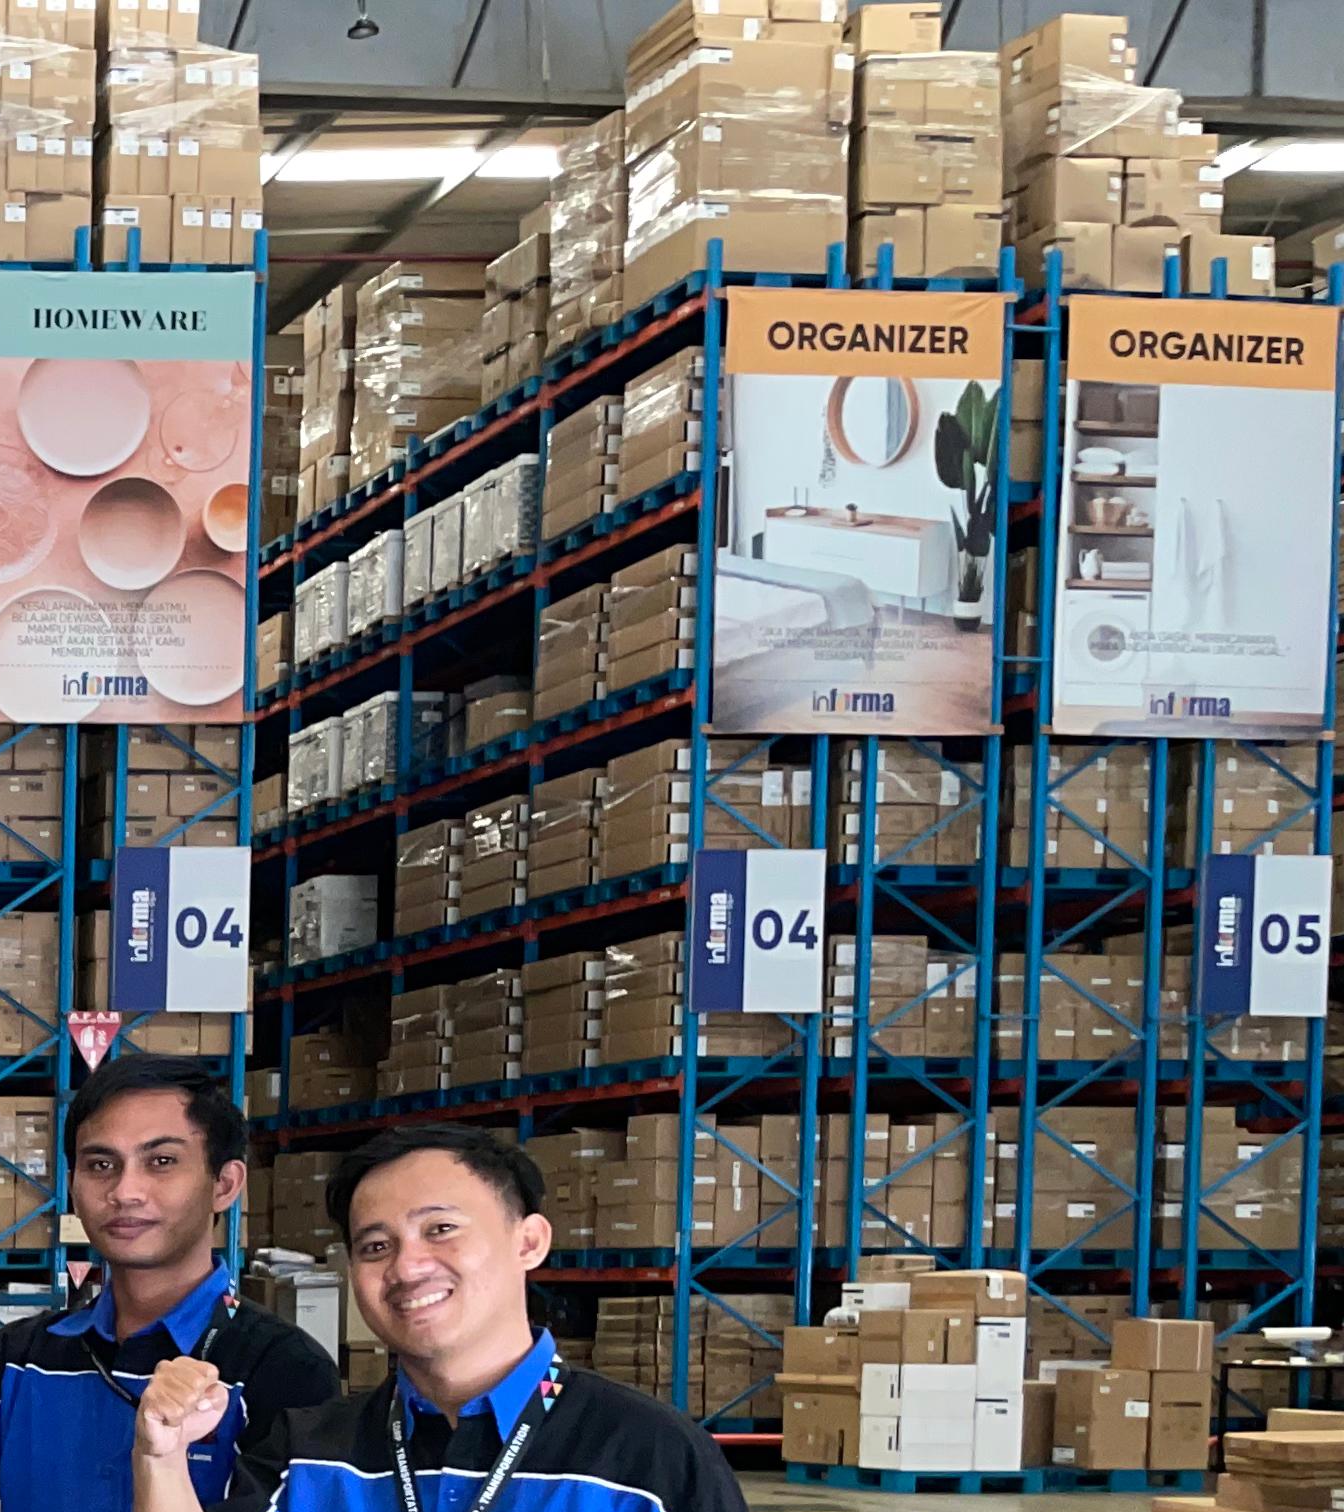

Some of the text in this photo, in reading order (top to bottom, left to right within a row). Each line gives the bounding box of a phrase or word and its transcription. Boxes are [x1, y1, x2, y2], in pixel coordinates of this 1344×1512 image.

[32, 307, 207, 332] HOMEWARE
[767, 321, 968, 354] ORGANIZER
[1109, 328, 1305, 365] ORGANIZER
[11, 612, 57, 623] BELAJAR
[27, 624, 67, 635] MAMPU
[17, 635, 186, 648] SAHABAT AKAN SETIA SAAT KAMU
[62, 670, 148, 696] informa
[812, 688, 894, 713] informa
[1149, 690, 1231, 718] informa
[128, 889, 150, 963] informa
[175, 907, 244, 949] 04
[706, 892, 727, 964] informa
[752, 909, 819, 950] 04
[1214, 896, 1236, 967] informa
[1260, 913, 1321, 955] 05
[478, 1422, 531, 1505] TRANSPORTATION
